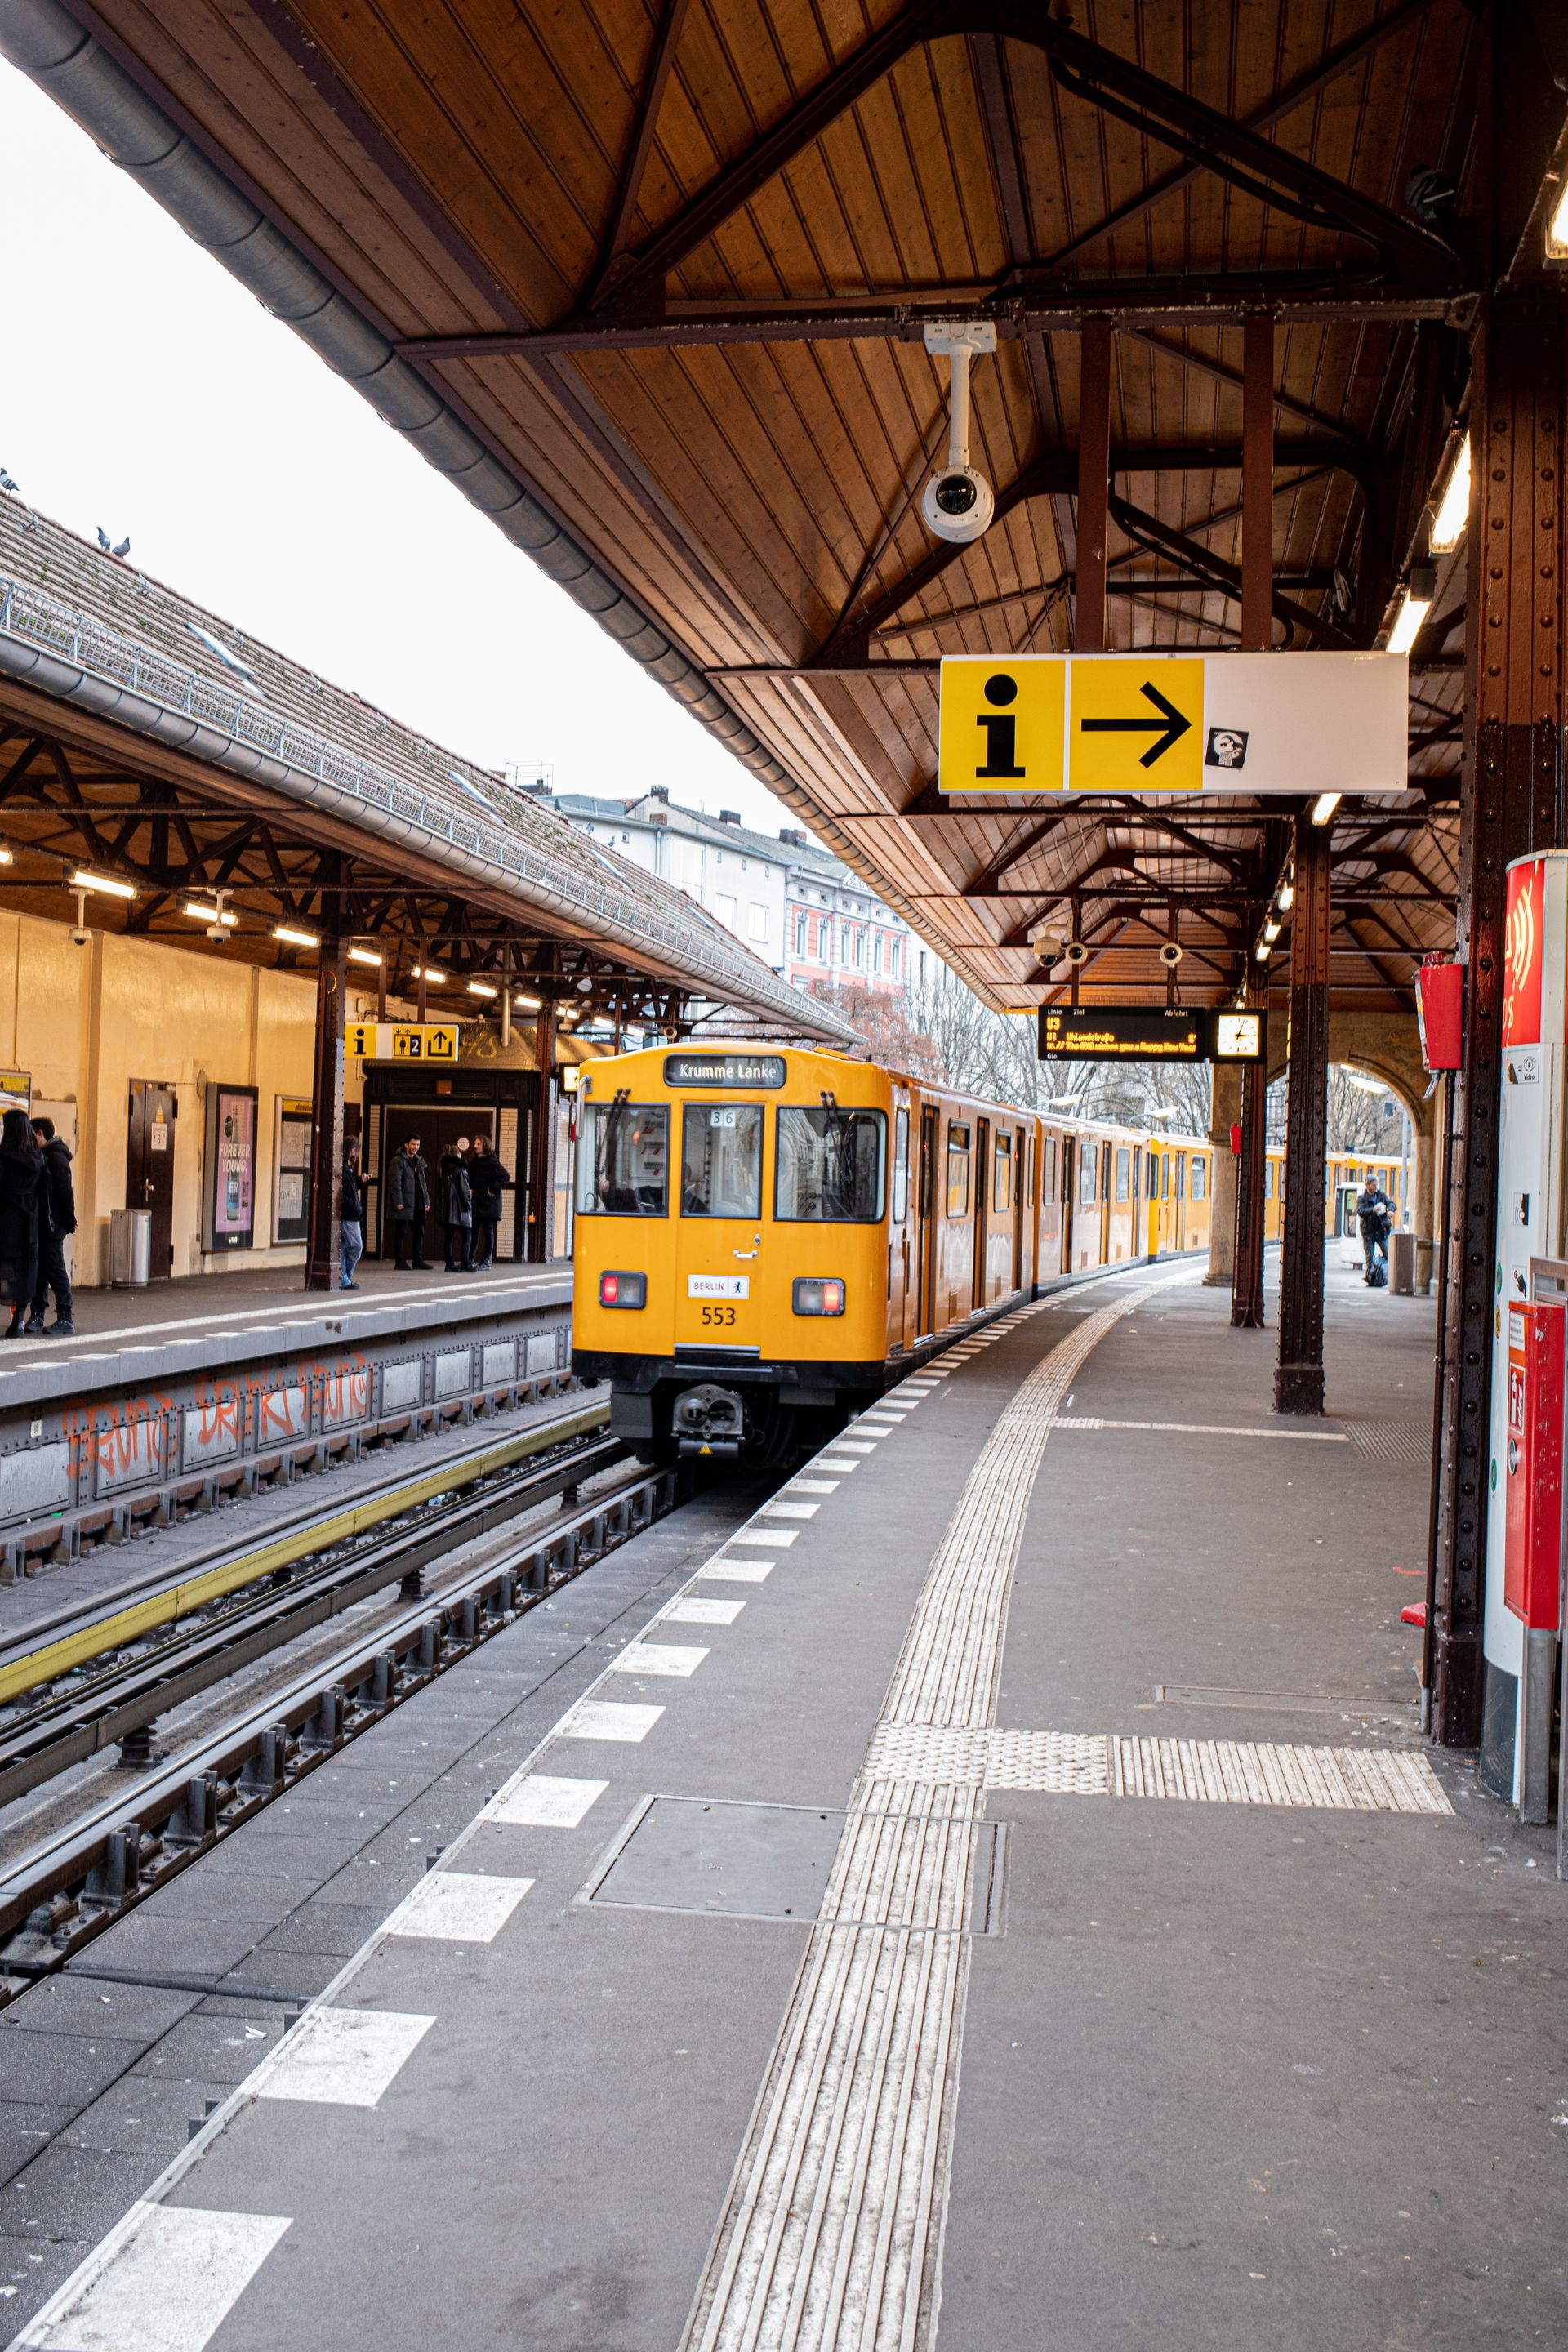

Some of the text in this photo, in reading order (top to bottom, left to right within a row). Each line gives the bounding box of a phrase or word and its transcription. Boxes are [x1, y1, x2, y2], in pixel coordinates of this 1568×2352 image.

[1046, 1017, 1061, 1031] U3
[1046, 1031, 1057, 1042] U1
[412, 1039, 420, 1053] 2
[679, 1063, 777, 1079] Krumme Lanke
[713, 1112, 733, 1124] 36
[219, 1143, 251, 1157] FOREVER
[693, 1282, 724, 1290] BERLIN
[702, 1307, 736, 1325] 553
